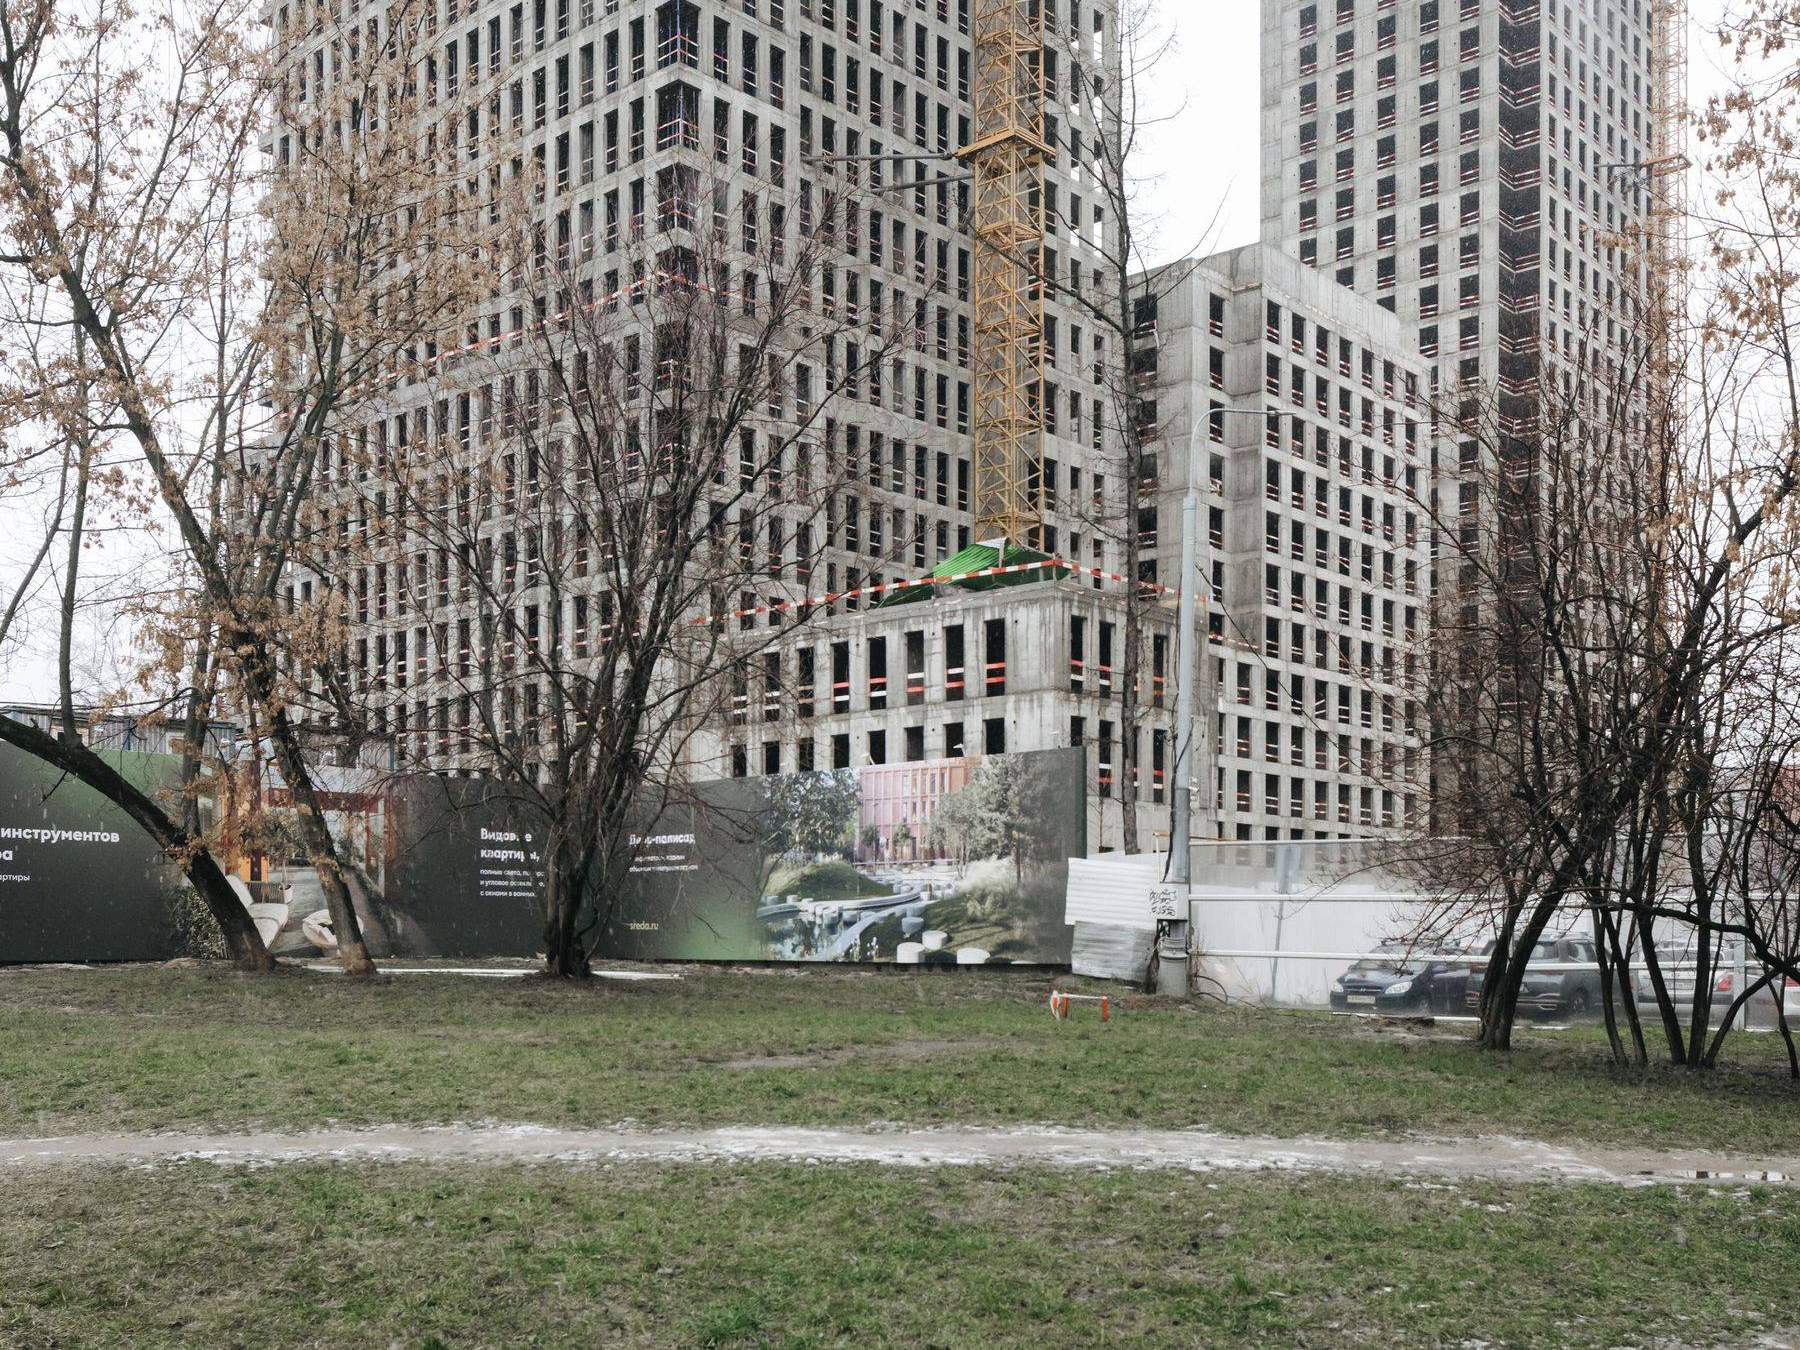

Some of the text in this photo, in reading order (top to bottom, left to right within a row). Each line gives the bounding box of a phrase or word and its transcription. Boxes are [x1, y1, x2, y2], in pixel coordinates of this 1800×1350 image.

[1, 828, 119, 843] инструментов
[480, 828, 532, 842] Видове
[629, 834, 696, 846] Двр-палисад
